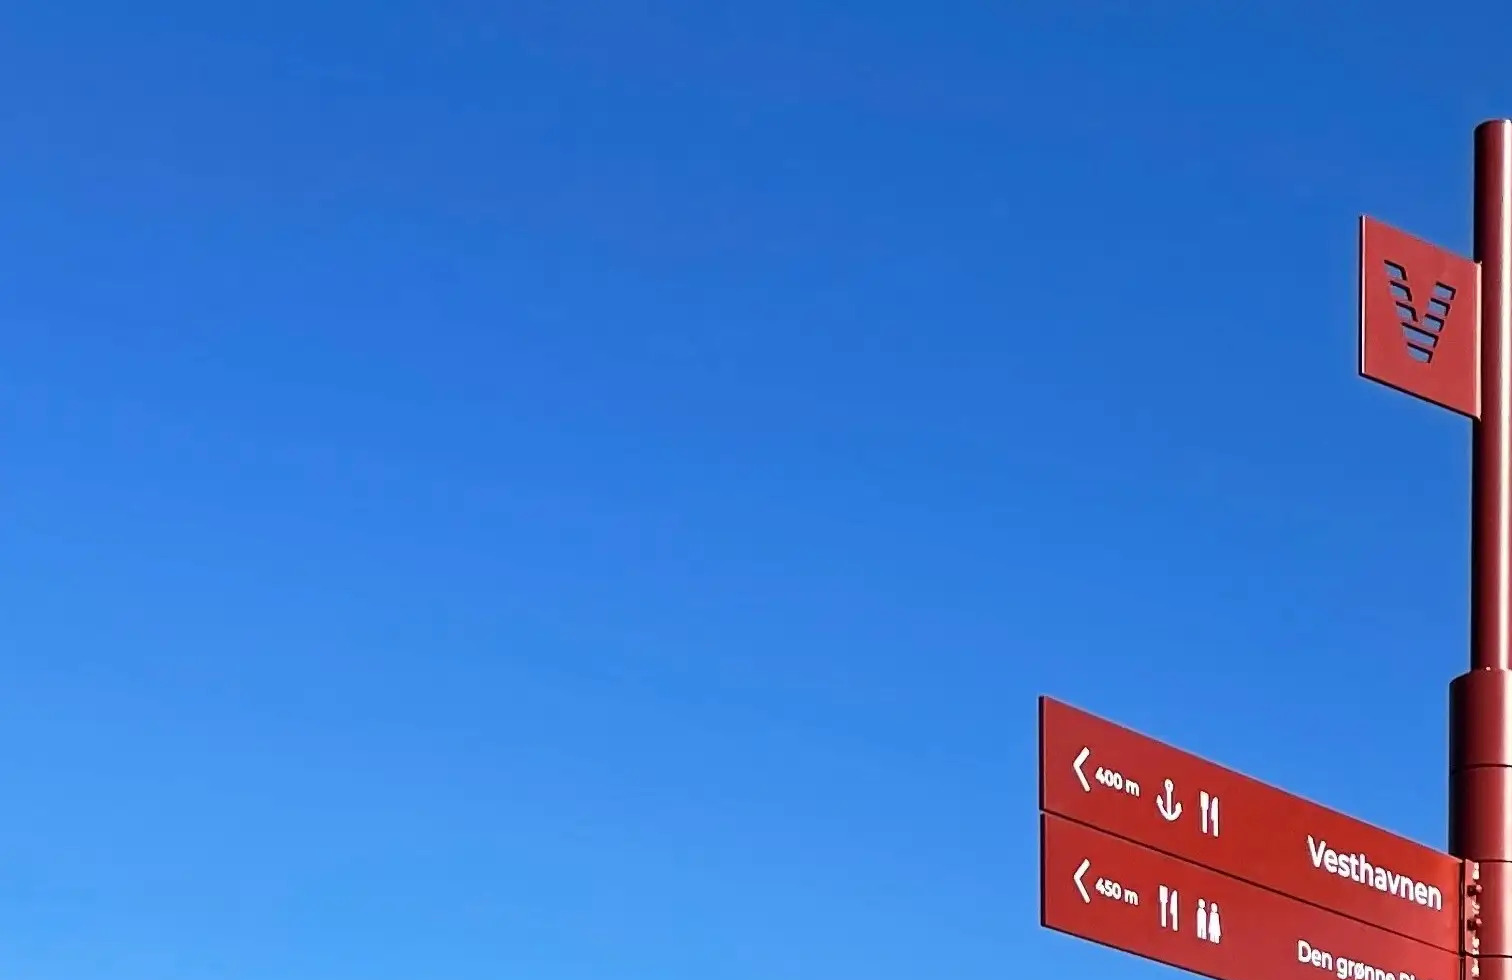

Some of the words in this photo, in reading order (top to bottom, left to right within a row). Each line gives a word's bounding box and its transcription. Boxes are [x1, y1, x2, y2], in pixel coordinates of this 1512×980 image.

[1095, 766, 1123, 791] 400
[1125, 778, 1141, 798] m
[1307, 834, 1442, 911] Vesthavnen
[1095, 877, 1122, 901] 450
[1123, 888, 1140, 907] m
[1296, 939, 1333, 971] Den
